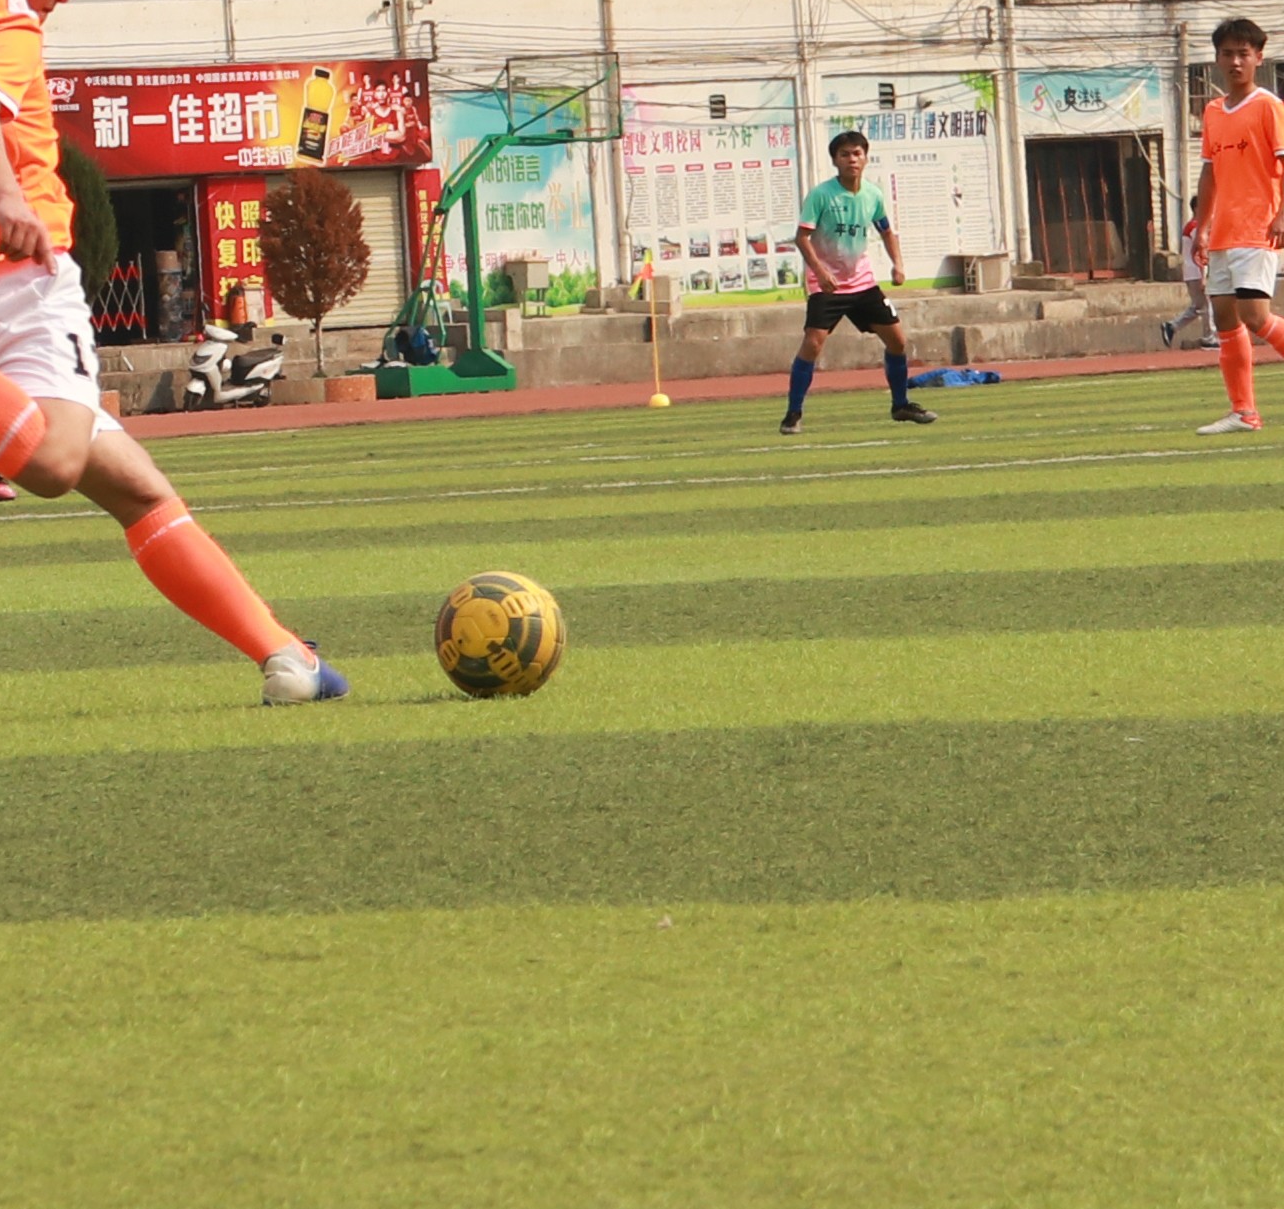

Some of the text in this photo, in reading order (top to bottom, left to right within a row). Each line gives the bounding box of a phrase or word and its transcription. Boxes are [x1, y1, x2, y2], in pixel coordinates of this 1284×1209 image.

[92, 92, 280, 149] 新一佳超市
[622, 128, 702, 156] 创建文明校园
[767, 124, 793, 148] 标准
[224, 146, 295, 168] 一中生活馆
[215, 200, 260, 230] 快照
[217, 236, 262, 268] 复印
